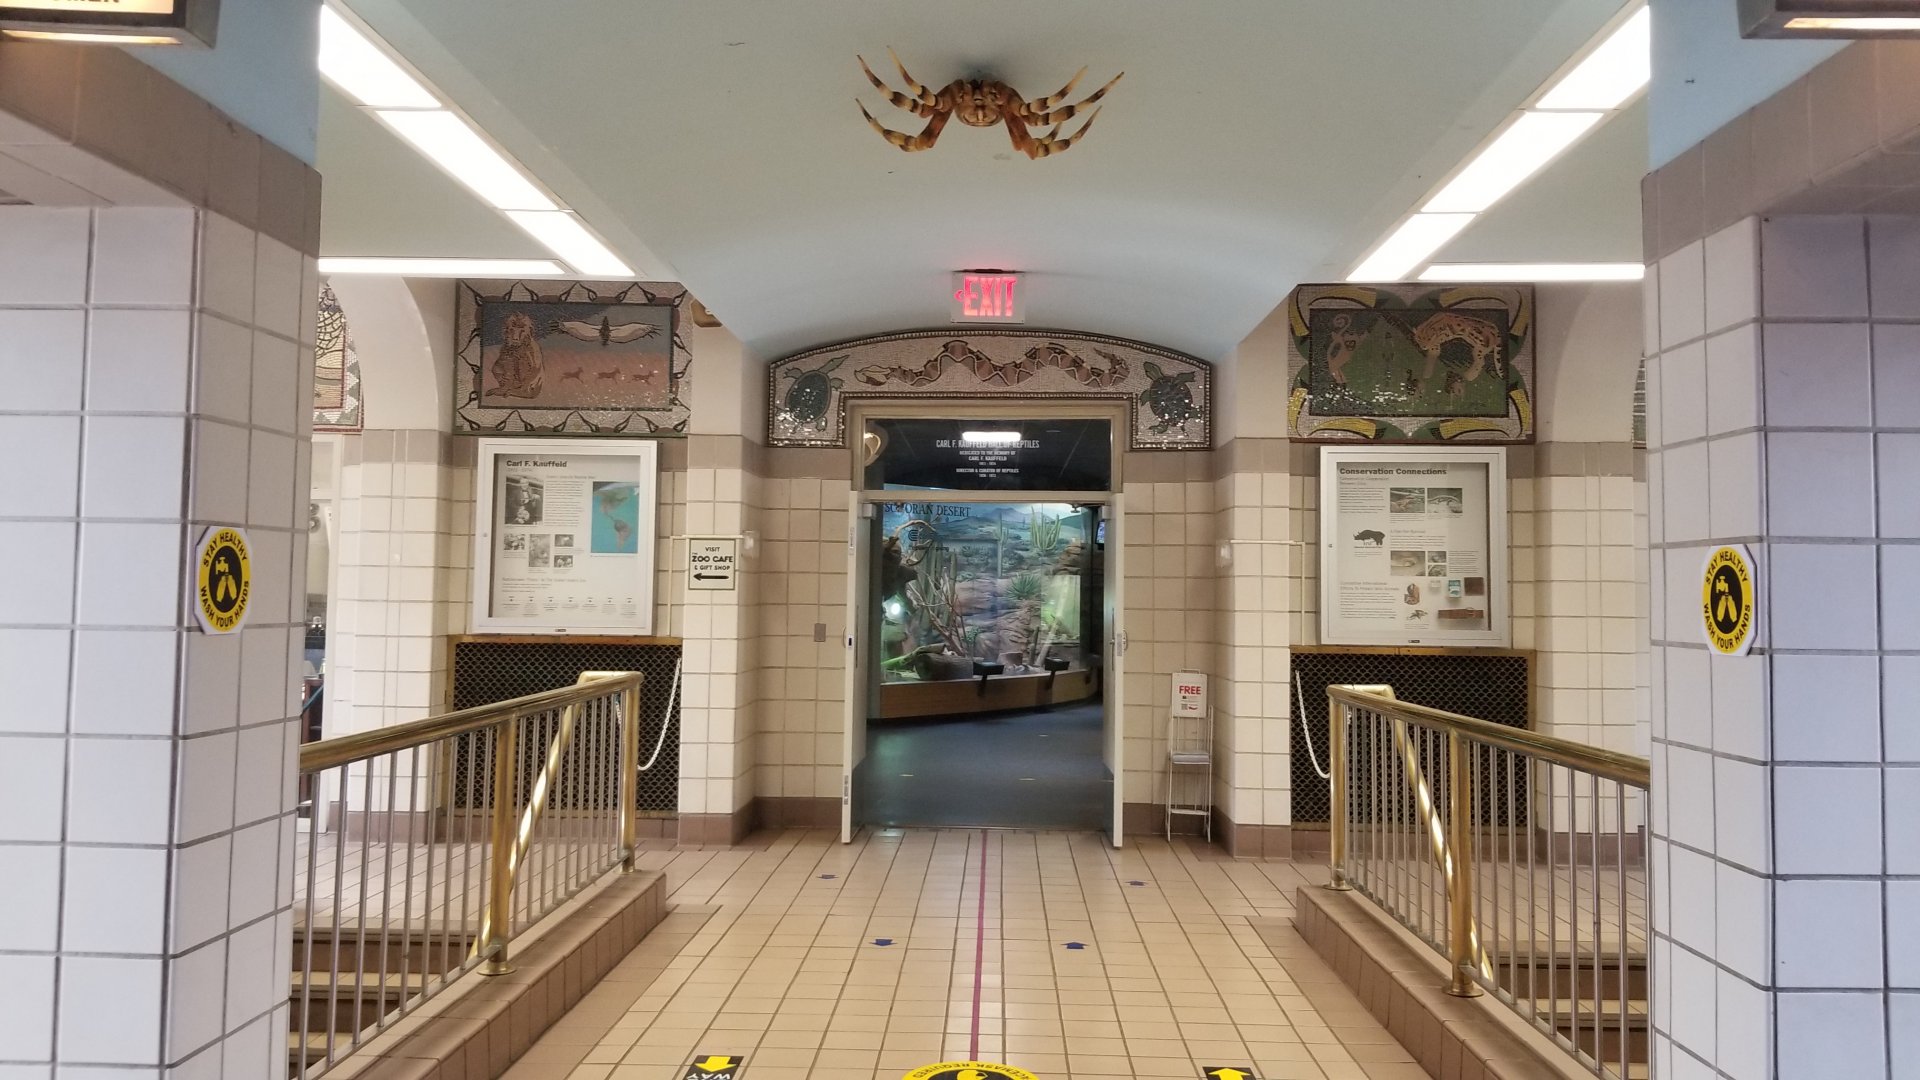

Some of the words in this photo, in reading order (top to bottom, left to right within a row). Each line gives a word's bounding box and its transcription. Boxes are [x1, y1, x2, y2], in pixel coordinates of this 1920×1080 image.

[963, 276, 1017, 316] EXIT
[936, 439, 951, 448] CARL
[958, 440, 987, 448] KAUFFELD
[1012, 440, 1040, 448] REPTILES
[937, 505, 971, 516] DESERT
[203, 537, 218, 568] STAY
[220, 532, 247, 560] HEALTHY
[1705, 558, 1719, 586] STAY
[1719, 551, 1748, 582] HEALTHY
[200, 585, 215, 620] WASH
[216, 616, 234, 627] YOUR
[233, 580, 250, 619] HANDS
[1703, 603, 1717, 637] WASH
[1716, 637, 1735, 649] YOUR
[1733, 604, 1752, 643] HANDS
[1179, 686, 1201, 694] FREE
[912, 1063, 971, 1079] REQUIRED
